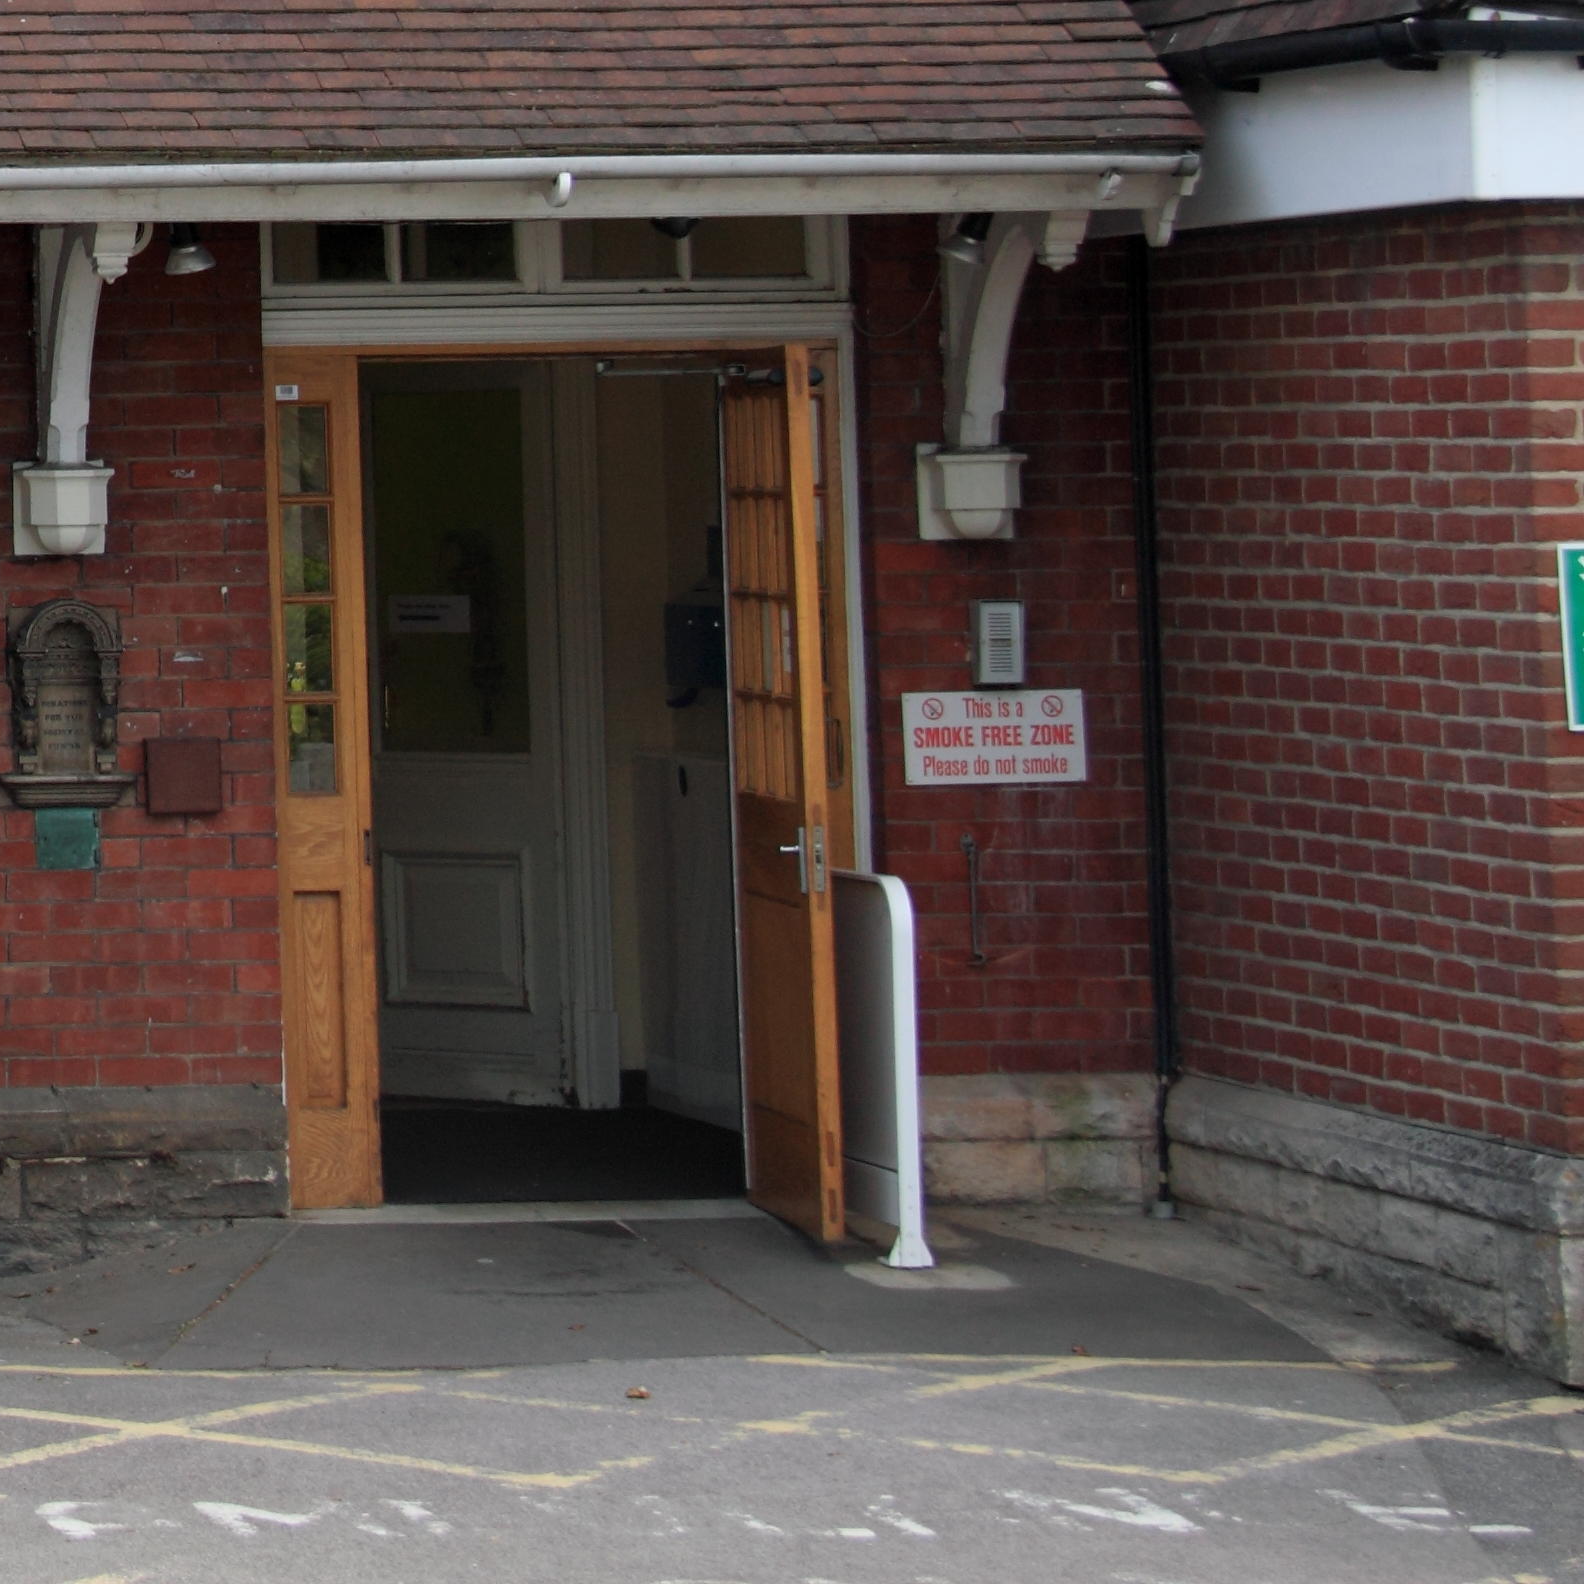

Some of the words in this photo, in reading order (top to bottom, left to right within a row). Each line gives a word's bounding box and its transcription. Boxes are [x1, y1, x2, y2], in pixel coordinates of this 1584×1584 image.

[962, 697, 992, 718] This
[998, 697, 1010, 717] is
[1016, 700, 1023, 716] a
[914, 726, 973, 748] SMOKE
[981, 725, 1022, 746] FREE
[1030, 724, 1074, 744] ZONE
[923, 755, 968, 776] Please
[974, 754, 989, 775] do
[996, 756, 1017, 774] not
[1023, 754, 1068, 773] smoke
